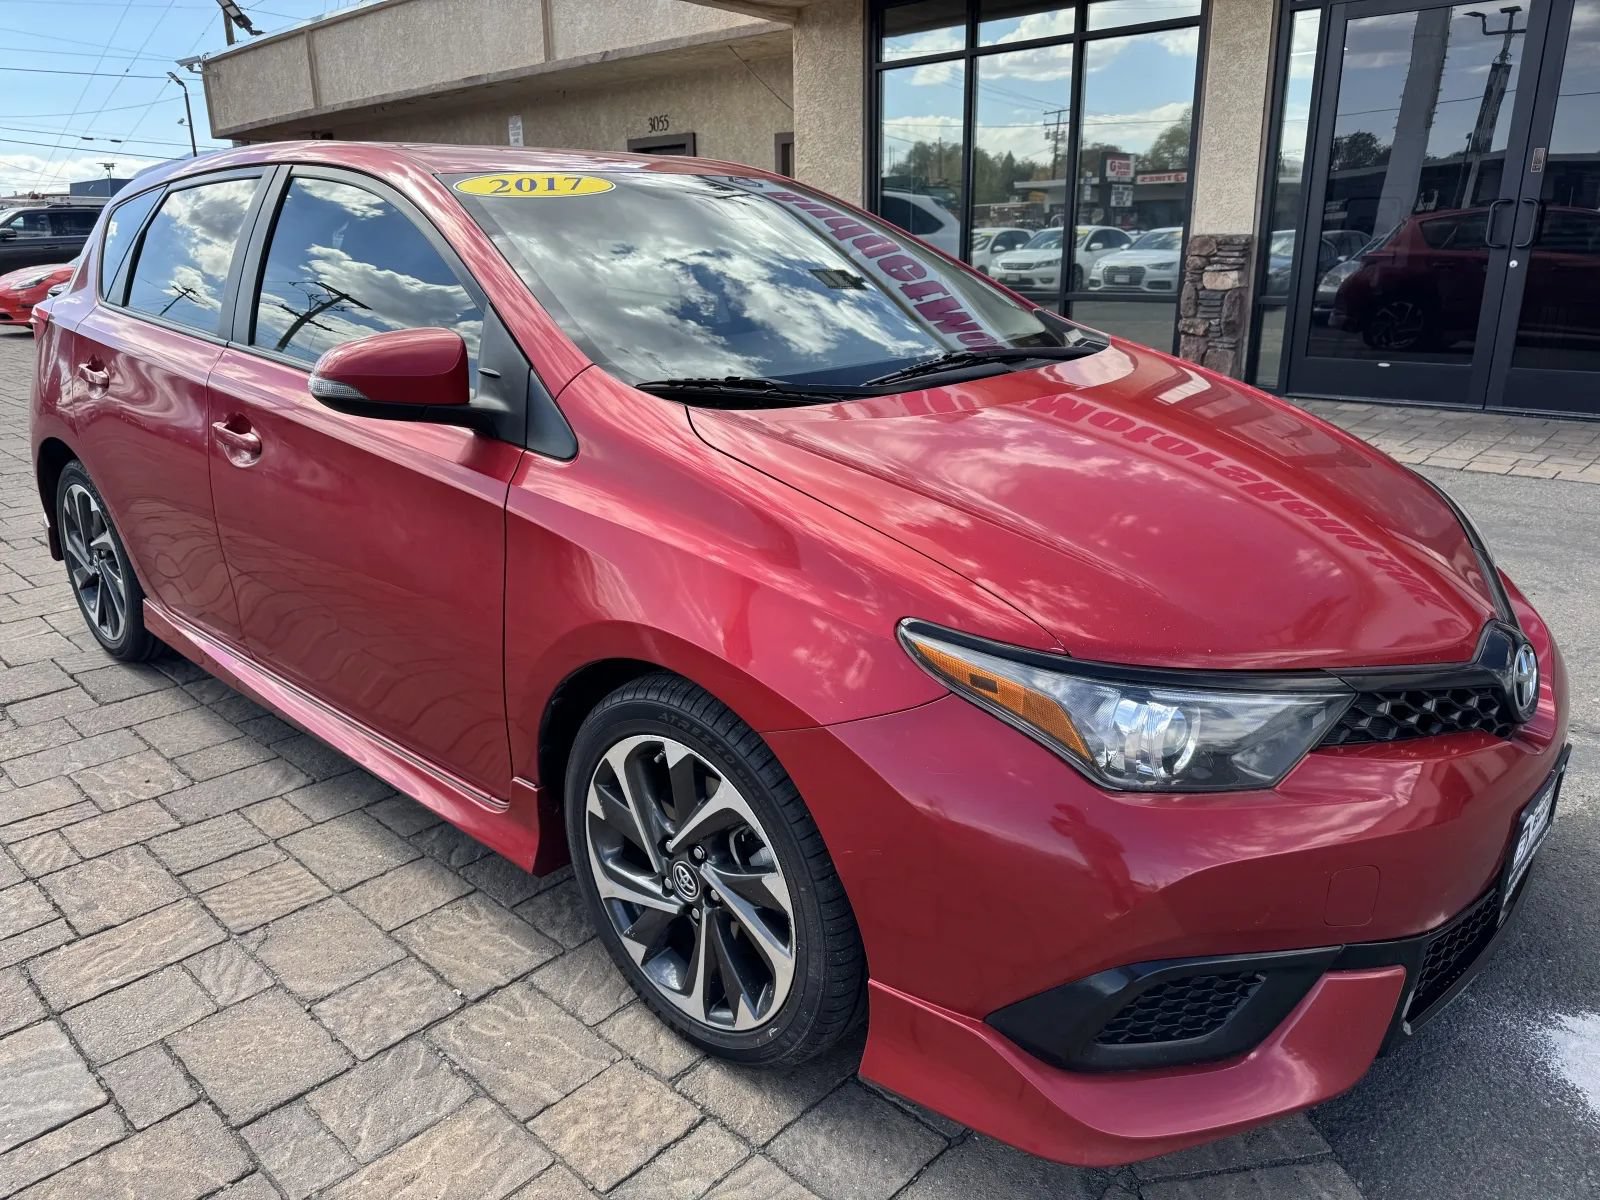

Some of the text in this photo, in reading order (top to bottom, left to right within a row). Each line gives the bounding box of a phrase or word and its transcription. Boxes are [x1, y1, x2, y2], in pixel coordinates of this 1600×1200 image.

[648, 114, 669, 133] 3055
[489, 177, 583, 194] 2017
[658, 712, 736, 764] ATREZZO
